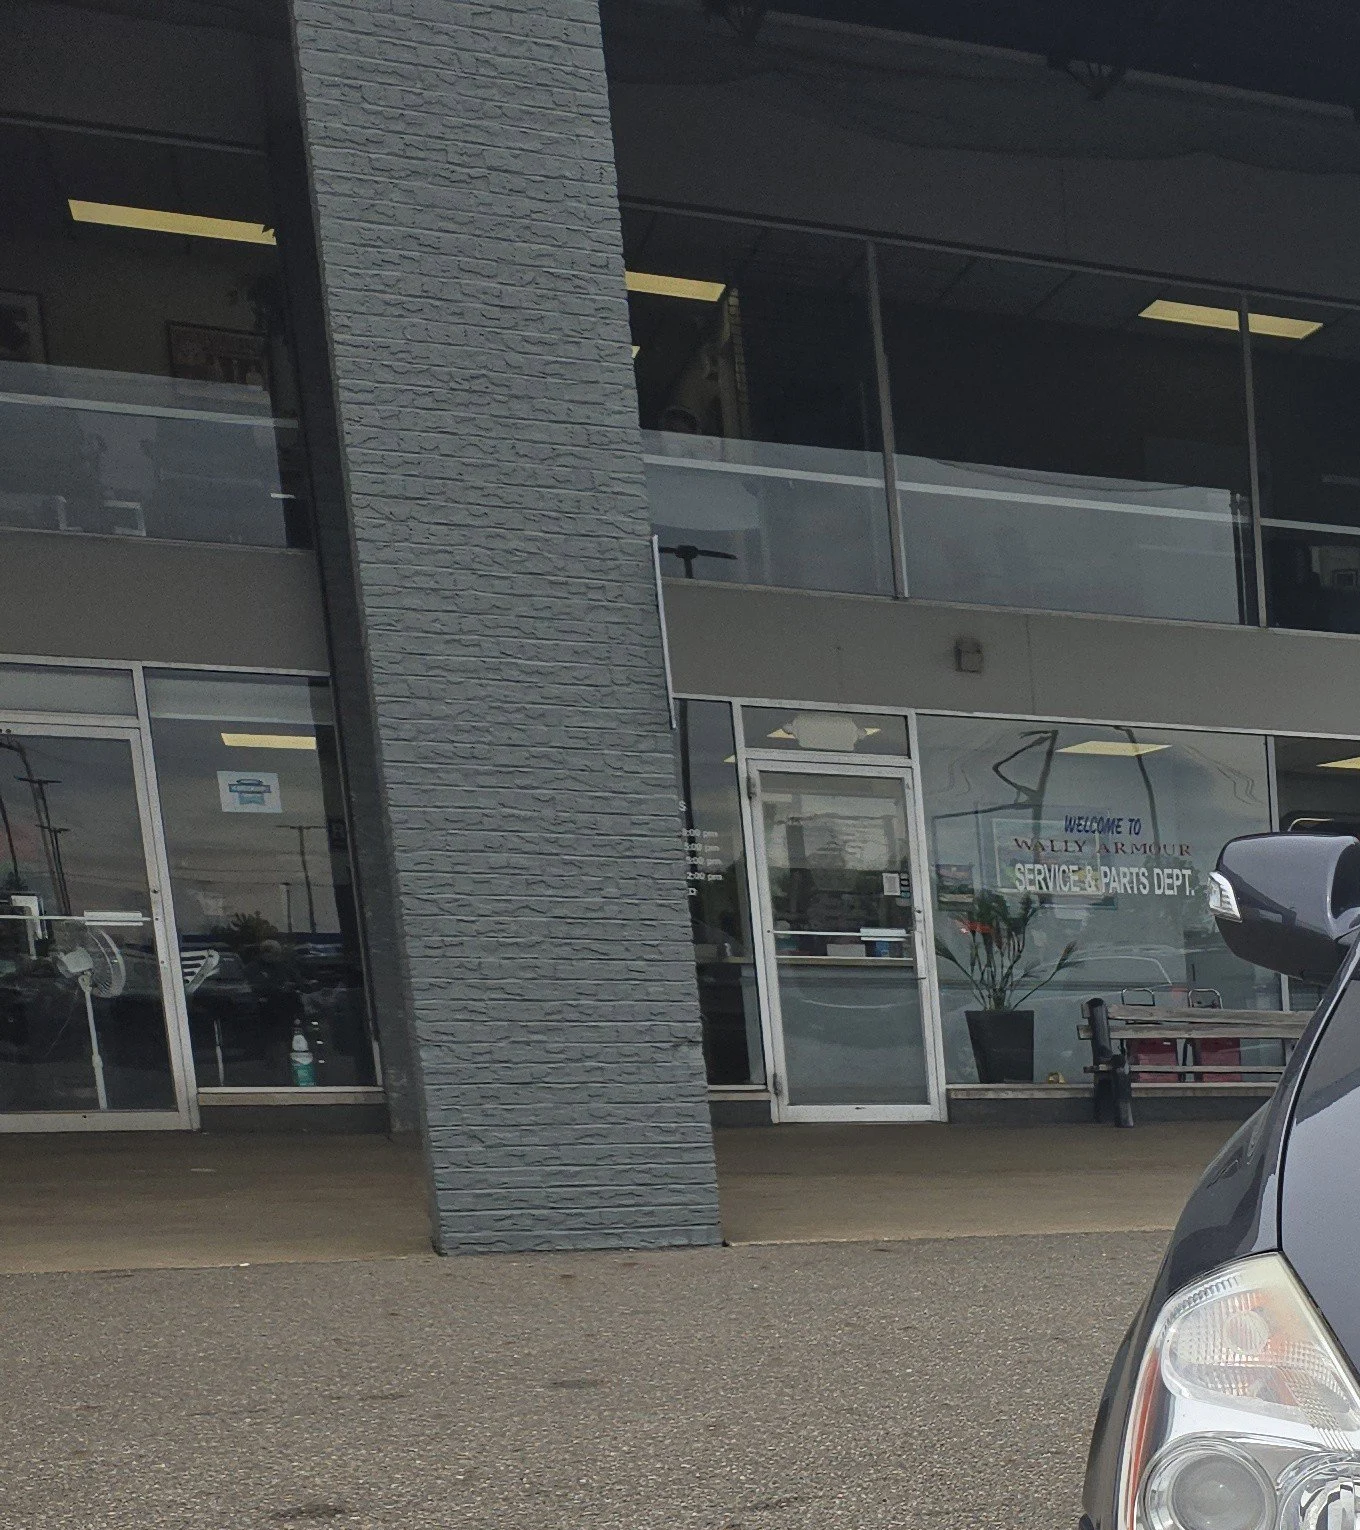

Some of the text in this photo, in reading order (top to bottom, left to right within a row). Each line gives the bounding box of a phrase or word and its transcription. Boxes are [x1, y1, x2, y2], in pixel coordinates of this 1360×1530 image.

[1064, 814, 1142, 836] WELCOME TO
[1013, 837, 1193, 857] WALLY ARMOUR
[1014, 863, 1195, 896] SERVICE & PARTS DEPT.
